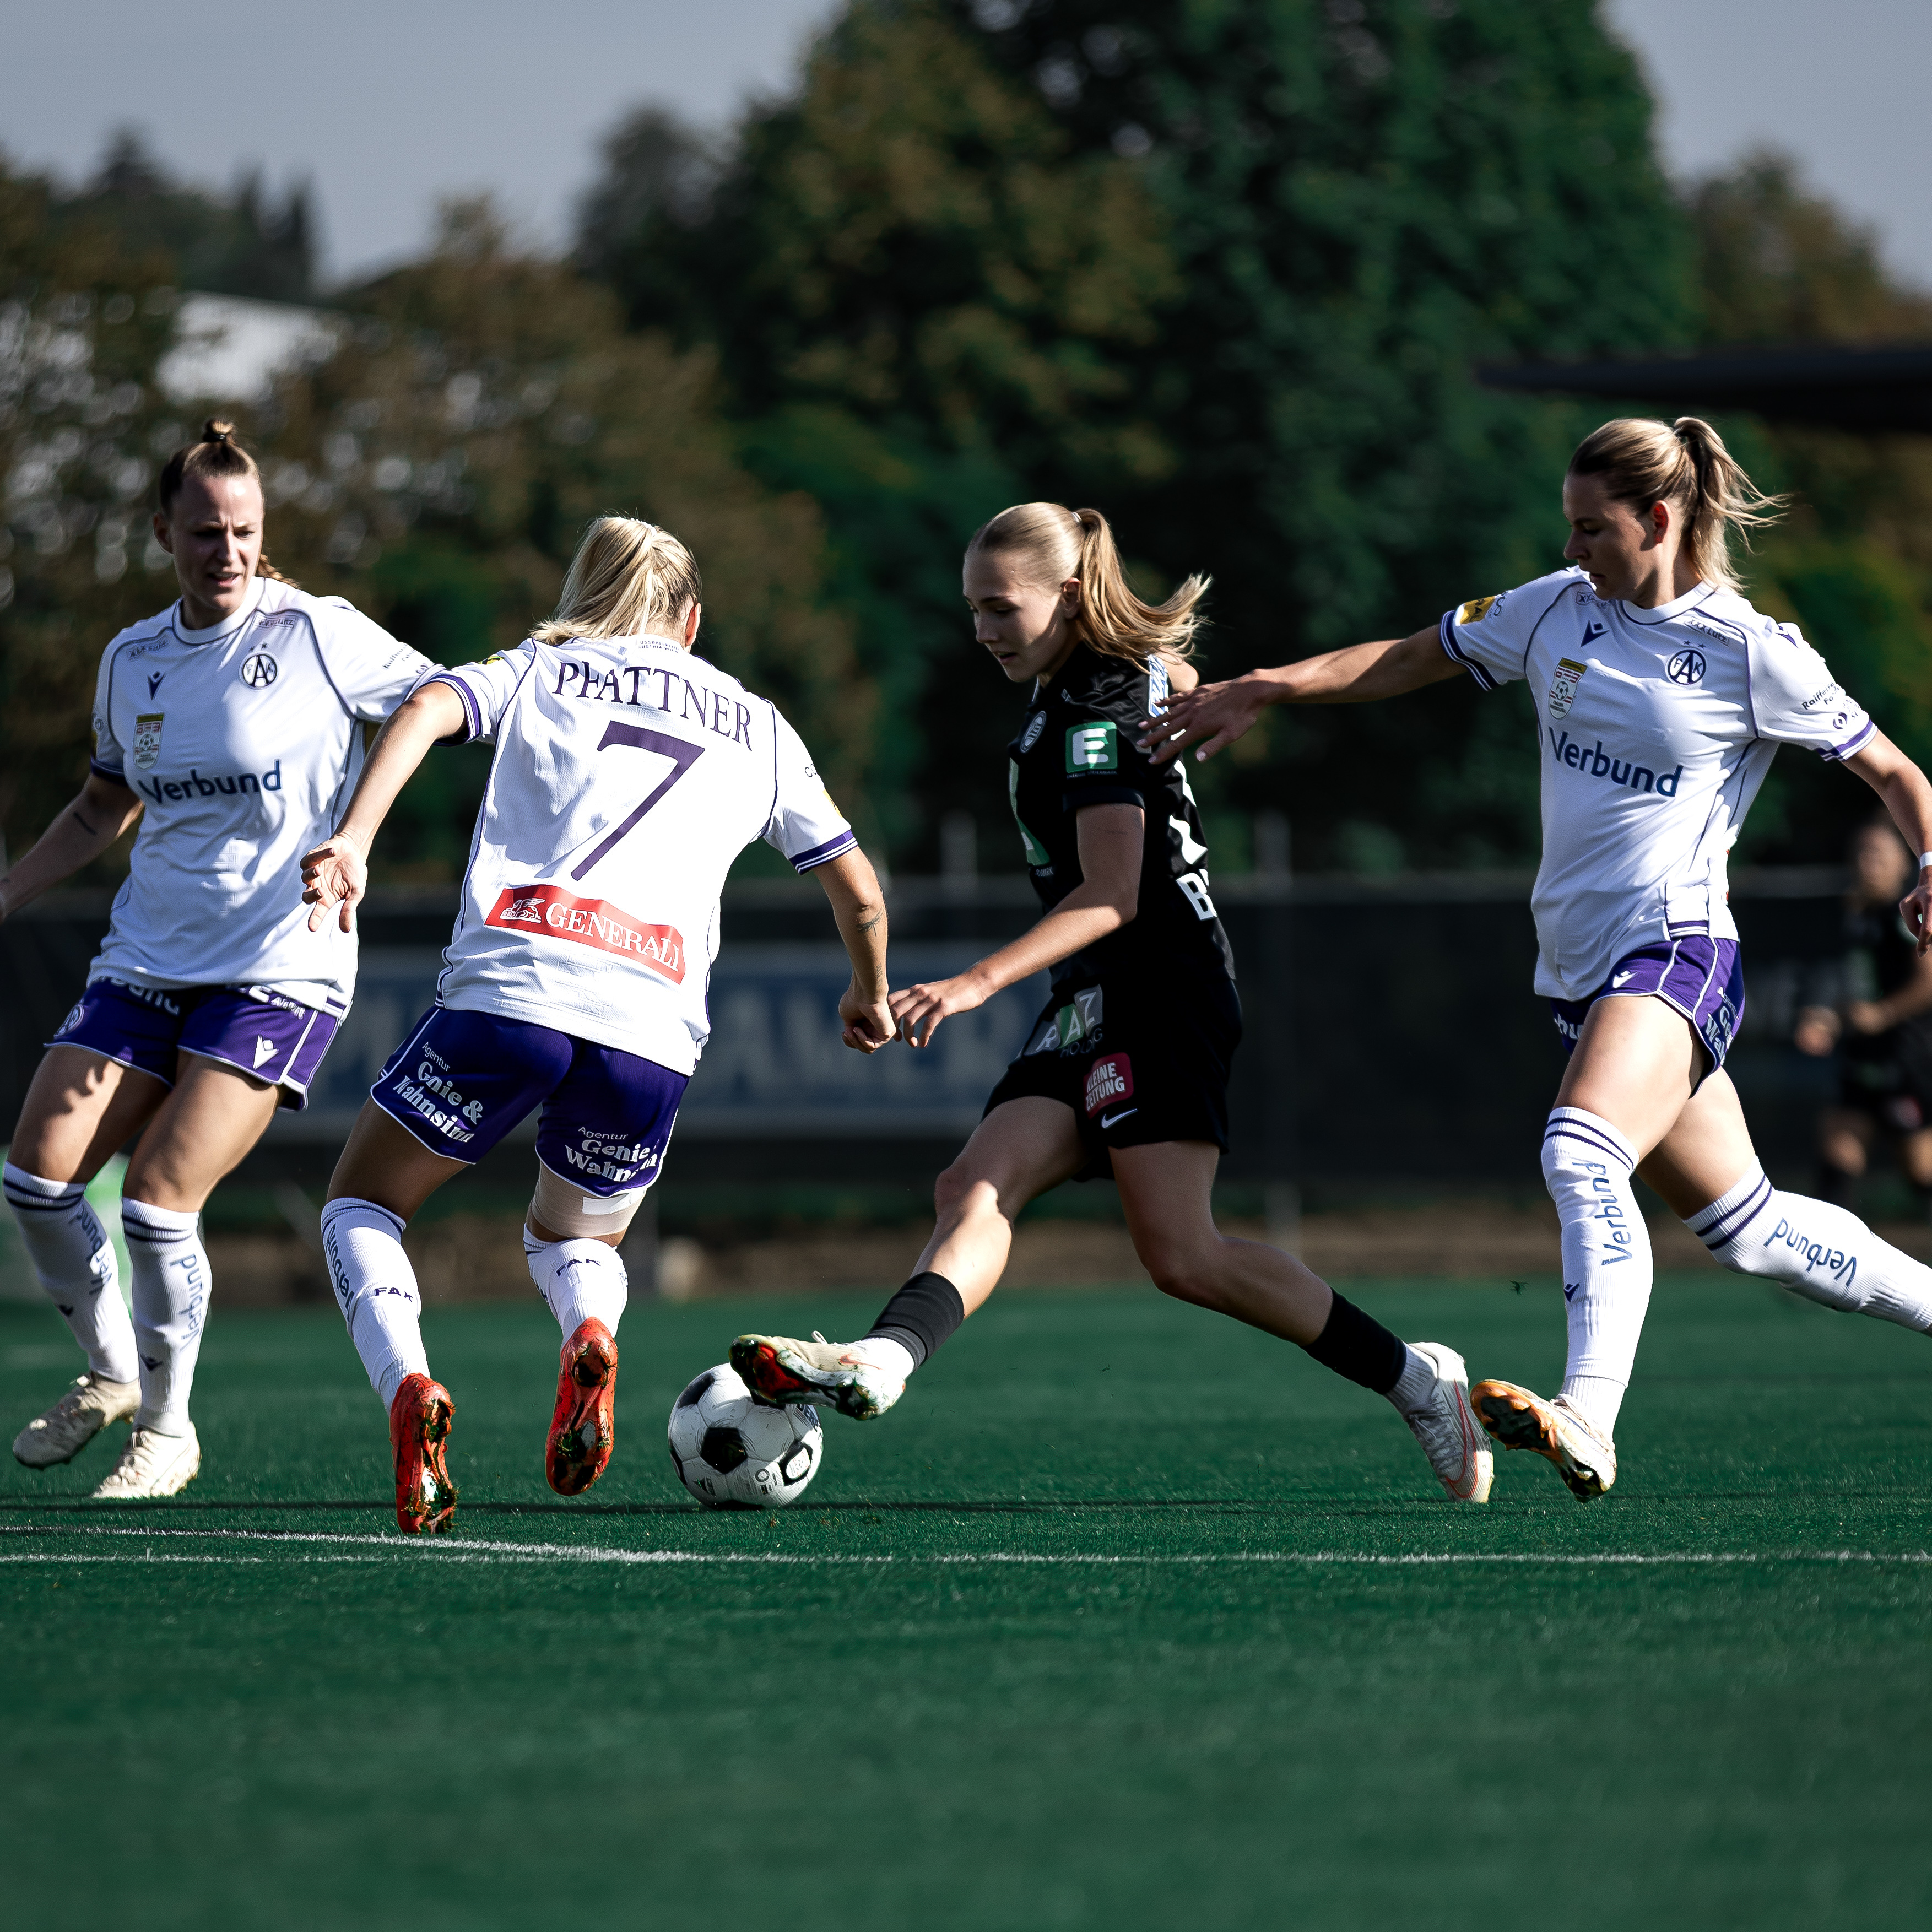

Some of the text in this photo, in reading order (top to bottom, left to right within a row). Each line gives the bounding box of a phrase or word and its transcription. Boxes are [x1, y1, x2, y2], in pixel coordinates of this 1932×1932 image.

[1072, 728, 1108, 766] E
[1548, 726, 1684, 798] Verbund
[137, 758, 282, 804] Verbund
[570, 719, 705, 882] 7
[545, 902, 679, 972] GENERALI
[422, 1041, 451, 1072] Agentur
[1086, 1062, 1117, 1094] KLEINE
[418, 1061, 483, 1125] Gnie &
[1085, 1076, 1126, 1111] ZEITUNG
[578, 1126, 629, 1140] Agentur
[582, 1139, 651, 1162] Genie
[1571, 1161, 1633, 1266] Verbund
[1763, 1217, 1857, 1288] Verbund
[169, 1252, 203, 1352] Verbund
